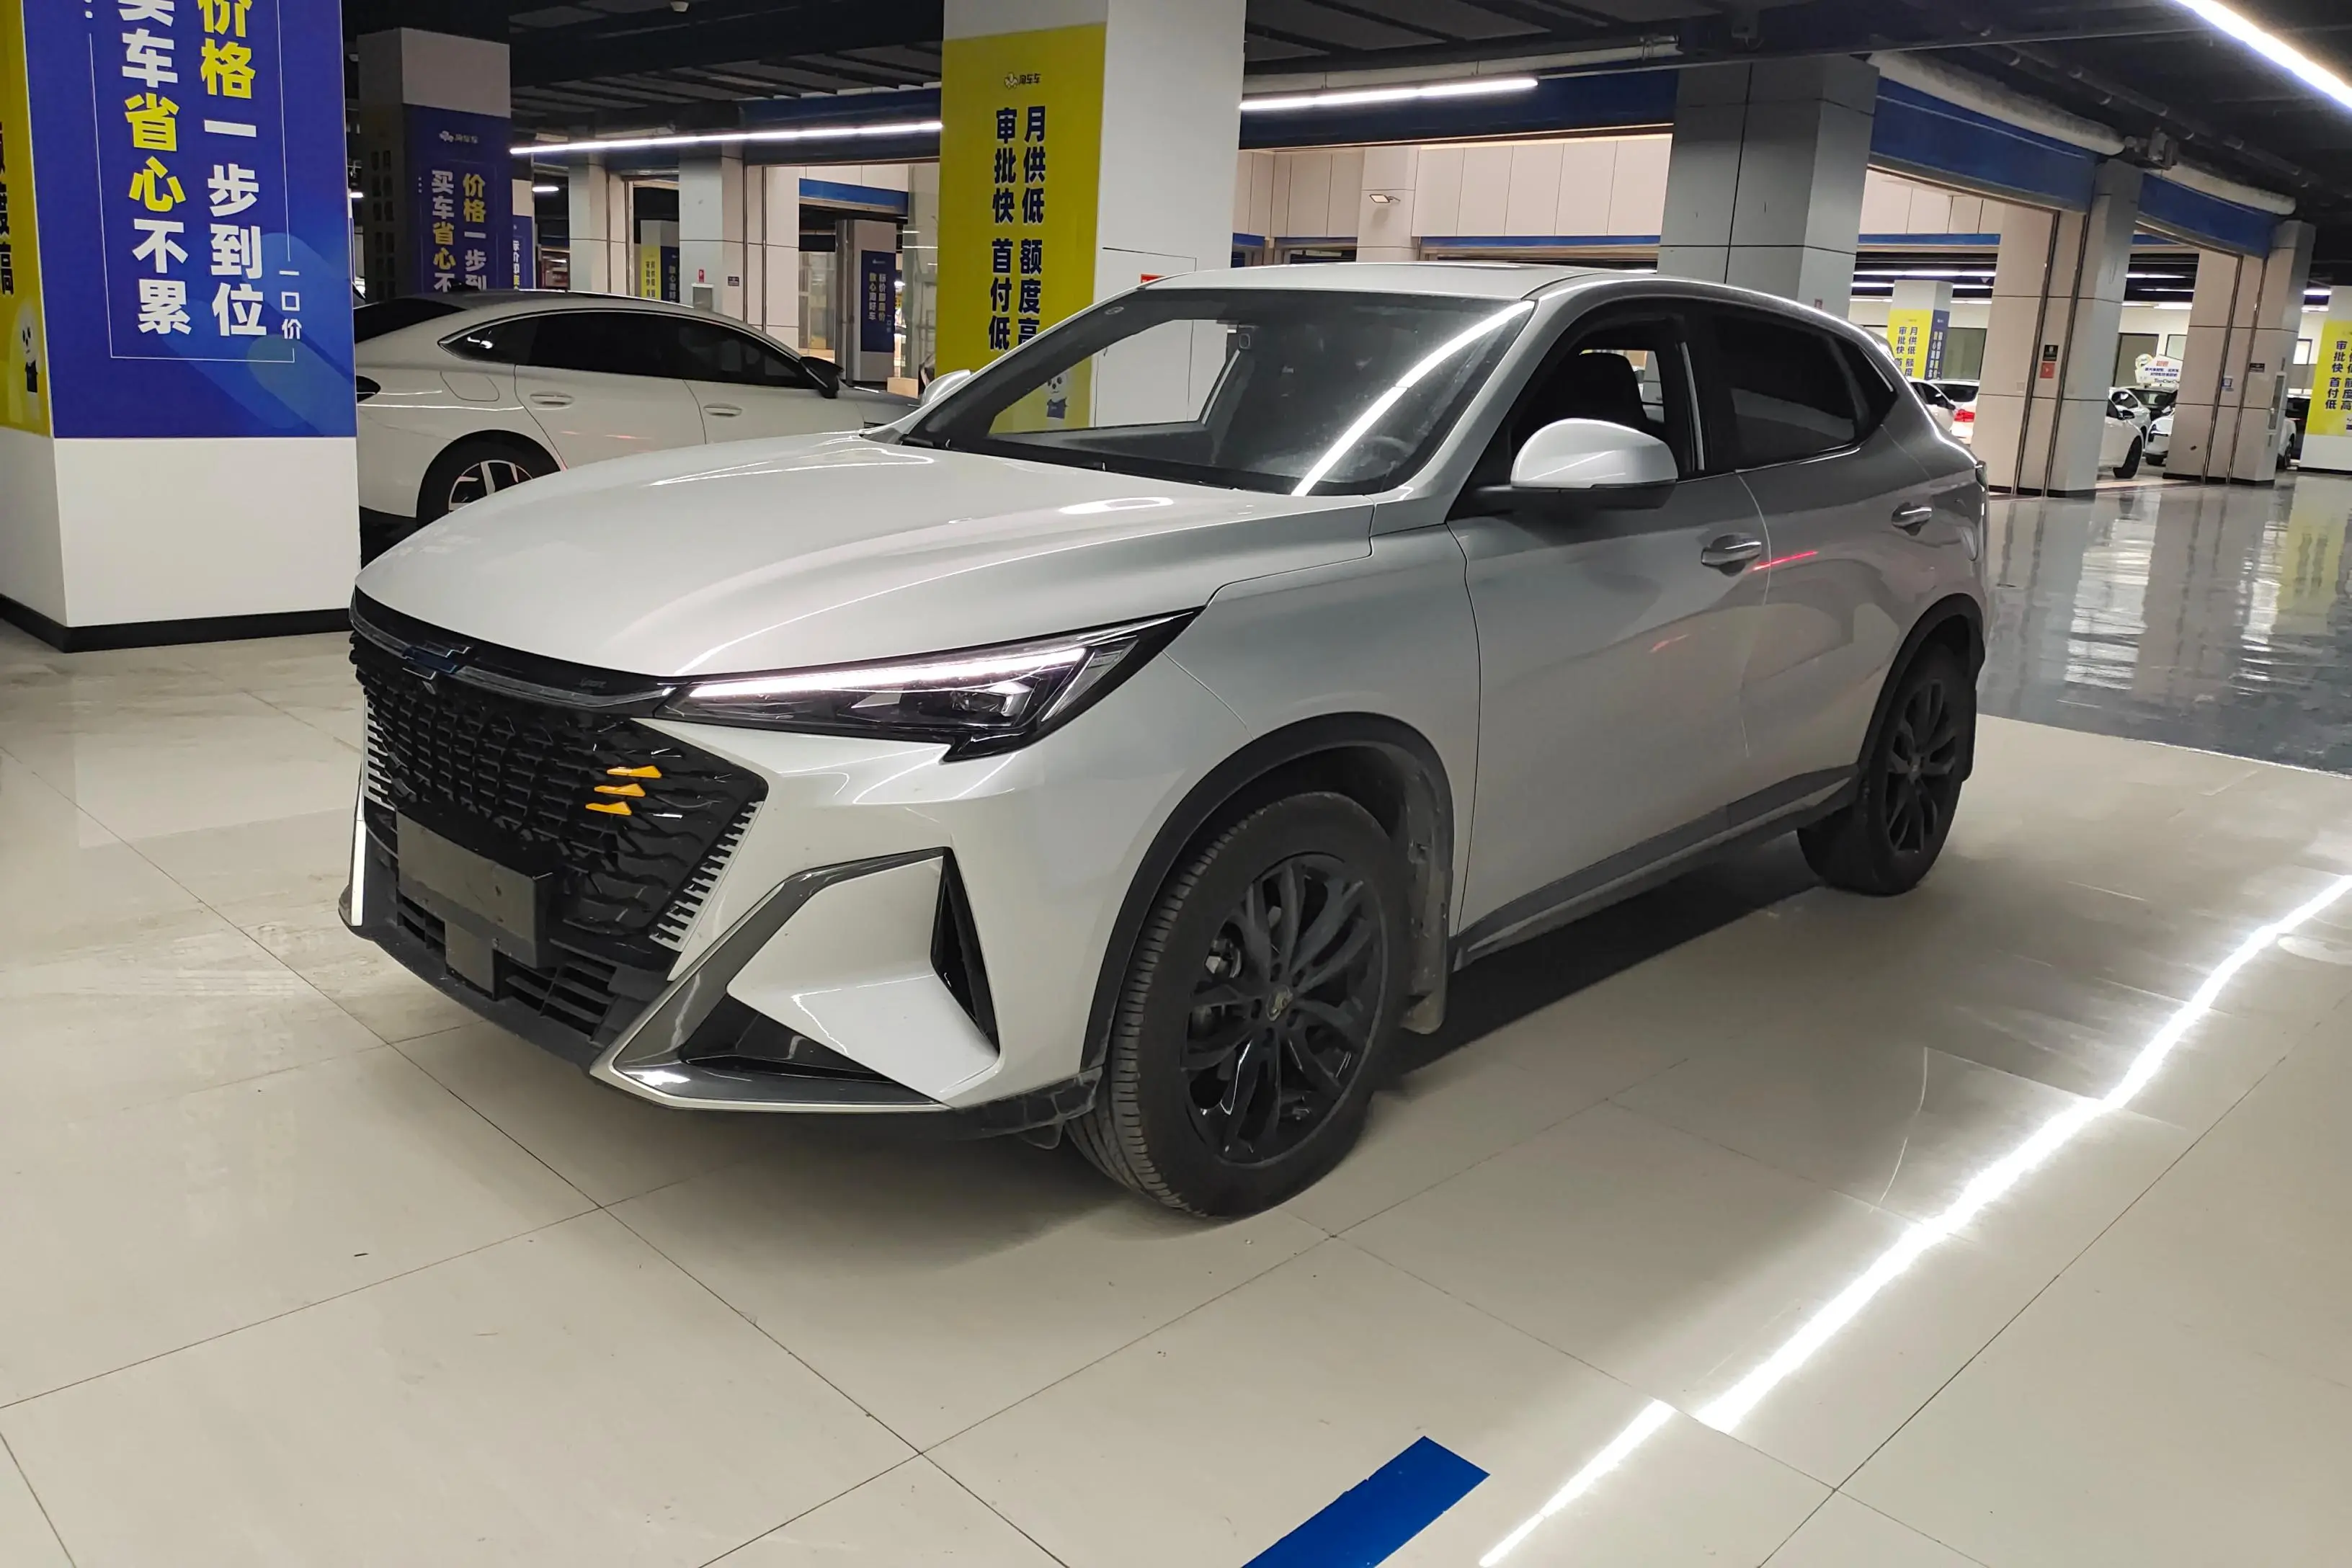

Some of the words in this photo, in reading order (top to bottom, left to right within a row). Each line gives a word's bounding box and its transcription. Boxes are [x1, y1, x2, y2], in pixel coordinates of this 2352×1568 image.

[197, 0, 267, 337] 价格一步到位
[992, 107, 1017, 224] 审批快
[1022, 105, 1046, 225] 月供低
[432, 169, 455, 293] 买车省心不
[463, 173, 487, 291] 价格一步到
[279, 270, 302, 339] 一口价
[989, 239, 1014, 350] 首付低
[1018, 239, 1043, 346] 额度高
